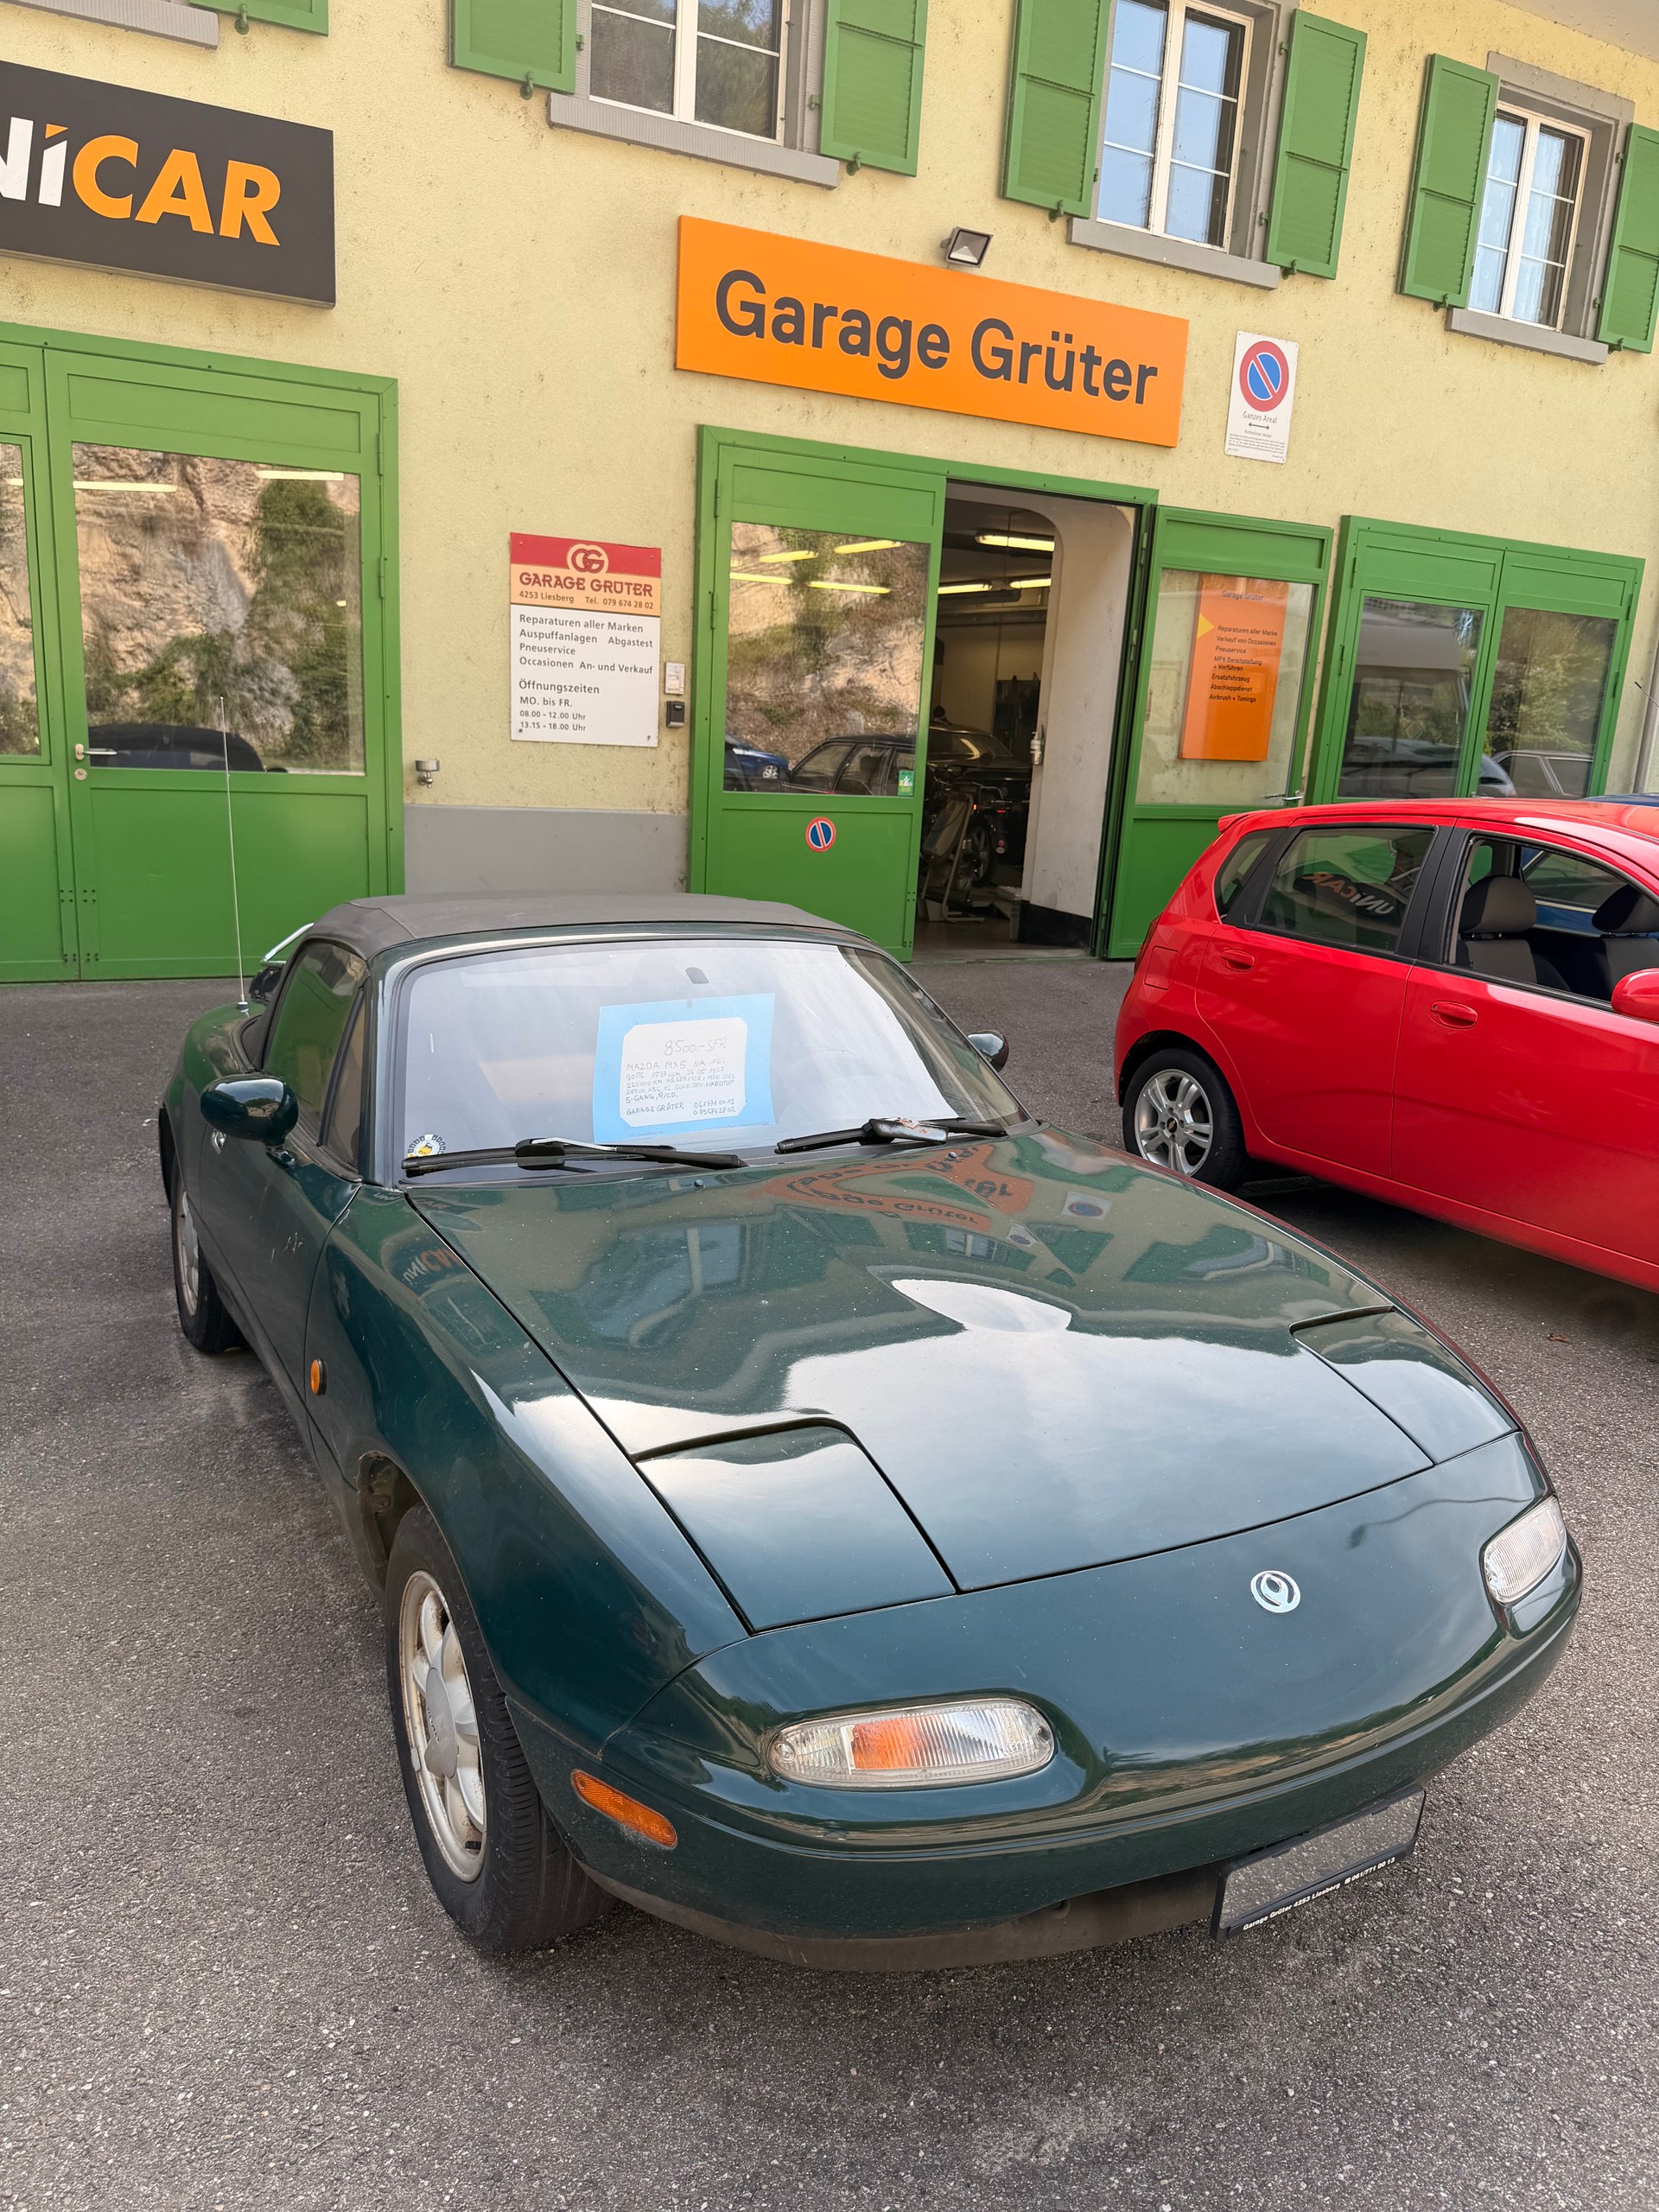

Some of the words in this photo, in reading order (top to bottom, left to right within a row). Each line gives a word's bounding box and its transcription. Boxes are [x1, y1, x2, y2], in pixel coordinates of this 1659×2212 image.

[715, 269, 950, 379] Garage
[970, 318, 1158, 404] Grüter
[1243, 410, 1262, 421] Ganzes
[1263, 415, 1278, 423] Areal
[519, 572, 586, 590] GARAGE
[519, 590, 538, 599] 4253
[541, 593, 574, 604] Liesberg
[1222, 590, 1243, 600] Garage
[585, 596, 599, 605] Tel.
[602, 598, 617, 607] 079
[519, 614, 581, 627] Reparaturen
[583, 620, 605, 630] aller
[607, 622, 644, 632] Marken
[1217, 625, 1249, 634] Reparaturen
[519, 629, 597, 645] Auspuffanlagen
[607, 637, 653, 648] Abgastest
[520, 643, 576, 655] Pneuservice
[1215, 645, 1246, 654] Pneuservice
[519, 657, 574, 669] Occasionen
[579, 661, 595, 670] An-
[618, 664, 653, 674] Verkauf
[518, 678, 600, 694] Öffnungszeiten
[1211, 683, 1252, 692] Abschleppdienst
[520, 696, 540, 705] MO.
[543, 697, 556, 707] bis
[559, 698, 573, 707] FR.
[549, 711, 569, 720] 12.00
[626, 1062, 659, 1071] MAZDA
[665, 1060, 687, 1070] MX5
[626, 1106, 655, 1116] GARAGE
[1243, 1916, 1268, 1930] Garage
[1269, 1904, 1293, 1918] Grüter
[1311, 1883, 1341, 1900] Liesberg
